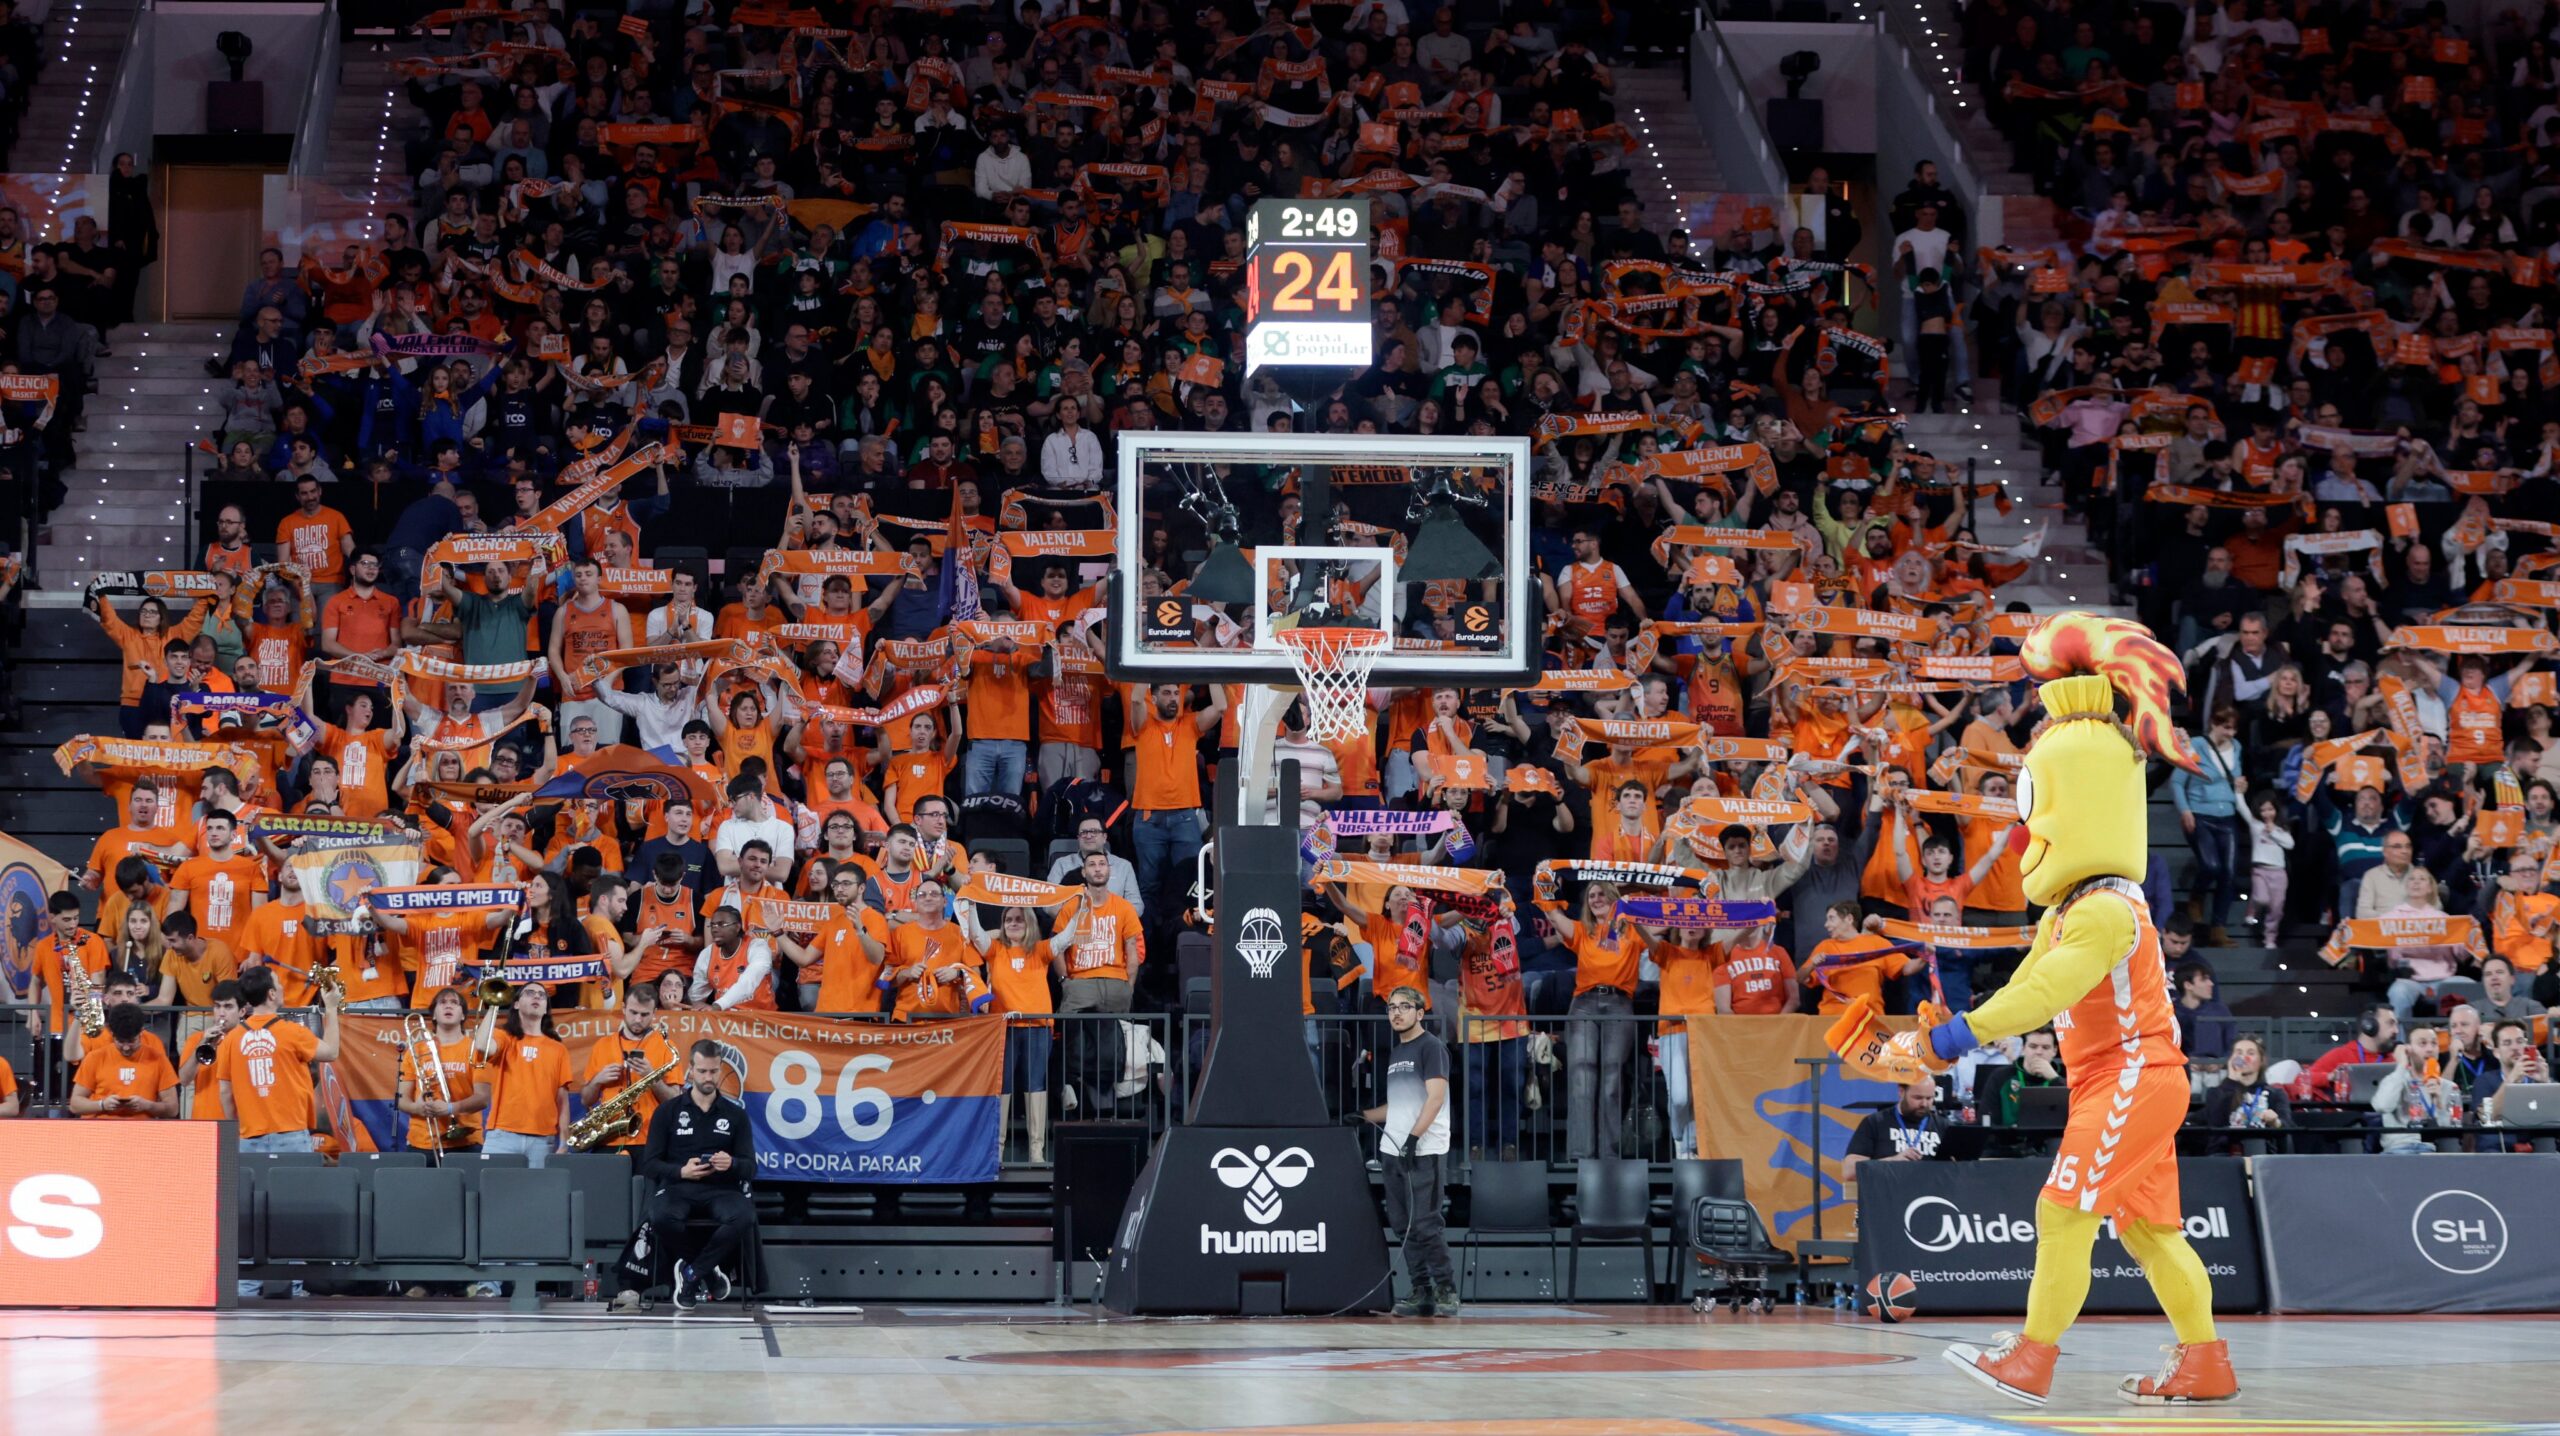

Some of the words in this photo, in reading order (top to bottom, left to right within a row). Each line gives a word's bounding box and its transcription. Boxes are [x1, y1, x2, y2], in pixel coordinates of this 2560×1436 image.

[1097, 163, 1148, 176] VALENCIA
[1281, 207, 1359, 238] 2:49
[964, 231, 1018, 246] VALENCIA
[1272, 251, 1359, 310] 24
[1296, 344, 1369, 359] popular
[12, 391, 38, 399] BASKET
[562, 443, 621, 476] VALENCIA
[1683, 447, 1743, 467] VALENCIA
[1698, 462, 1730, 476] BASKET
[553, 475, 613, 514] VALENCIA
[1540, 480, 1599, 495] ENCIA
[1702, 524, 1764, 537] VALENCIA
[1020, 531, 1085, 548] VALENCIA
[452, 540, 518, 557] VALENCIA
[1039, 546, 1071, 555] BASKET
[468, 556, 500, 566] BASKET
[809, 550, 875, 566] VALENCIA
[606, 568, 668, 582] VALENCIA
[826, 566, 858, 575] BASKET
[174, 571, 218, 587] BASK
[622, 583, 653, 593] BASKET
[972, 622, 1037, 638] VALENCIA
[1856, 613, 1917, 632] VALENCIA
[1870, 624, 1901, 635] BASKET
[781, 624, 844, 639] VALENCIA
[1148, 628, 1192, 639] EuroLeague
[1456, 632, 1499, 645] EuroLeague
[2442, 627, 2508, 644] VALENCIA
[1396, 638, 1444, 650] LENCIA
[1056, 645, 1098, 662] LENCI
[909, 660, 941, 669] BASKET
[1807, 655, 1868, 669] VALENCIA
[1927, 657, 1994, 668] PAMESA
[1545, 669, 1613, 682] VALENCIA
[1927, 668, 1995, 680] VALENCIA
[1565, 680, 1600, 690] BASKET
[204, 696, 260, 706] PAMESA
[1604, 722, 1671, 738] VALENCIA
[105, 740, 162, 758] VALENCIA
[164, 744, 212, 760] BASKET
[1718, 798, 1793, 813] VALENCIA
[1738, 813, 1776, 823] BASKET
[260, 817, 385, 836] CARABASSA
[1337, 823, 1393, 834] BASKET
[1395, 823, 1432, 833] CLUB
[1377, 862, 1461, 879] VALENCIA
[1577, 870, 1637, 884] BASKET
[1633, 874, 1676, 886] CLUB
[984, 874, 1057, 894] VALENCIA
[1397, 873, 1440, 886] BASKET
[406, 890, 452, 907] ANYS
[457, 888, 492, 906] AMB
[498, 889, 521, 905] TU
[1002, 894, 1039, 905] BASKET
[764, 900, 831, 919] VALENCIA
[1661, 903, 1729, 917] P.B.G.
[1919, 922, 1989, 937] VALENCIA
[2379, 918, 2446, 936] VALENCIA
[502, 965, 543, 984] ANYS
[549, 962, 583, 978] AMB
[1745, 979, 1772, 994] 1949
[377, 1027, 401, 1044] 40
[555, 1020, 594, 1037] OLT
[681, 1015, 698, 1034] SI
[700, 1018, 714, 1035] A
[719, 1013, 811, 1042] VALÈNCIA
[817, 1030, 854, 1044] HAS
[860, 1032, 885, 1046] DE
[889, 1027, 955, 1046] JUGAR
[770, 1050, 896, 1140] 86
[785, 1149, 847, 1172] PODRÀ
[859, 1155, 921, 1173] PARAR
[7, 1173, 104, 1260] S
[2432, 1219, 2487, 1242] SH
[1201, 1223, 1327, 1256] hummel
[1910, 1267, 2036, 1283] Electrodoméstic
